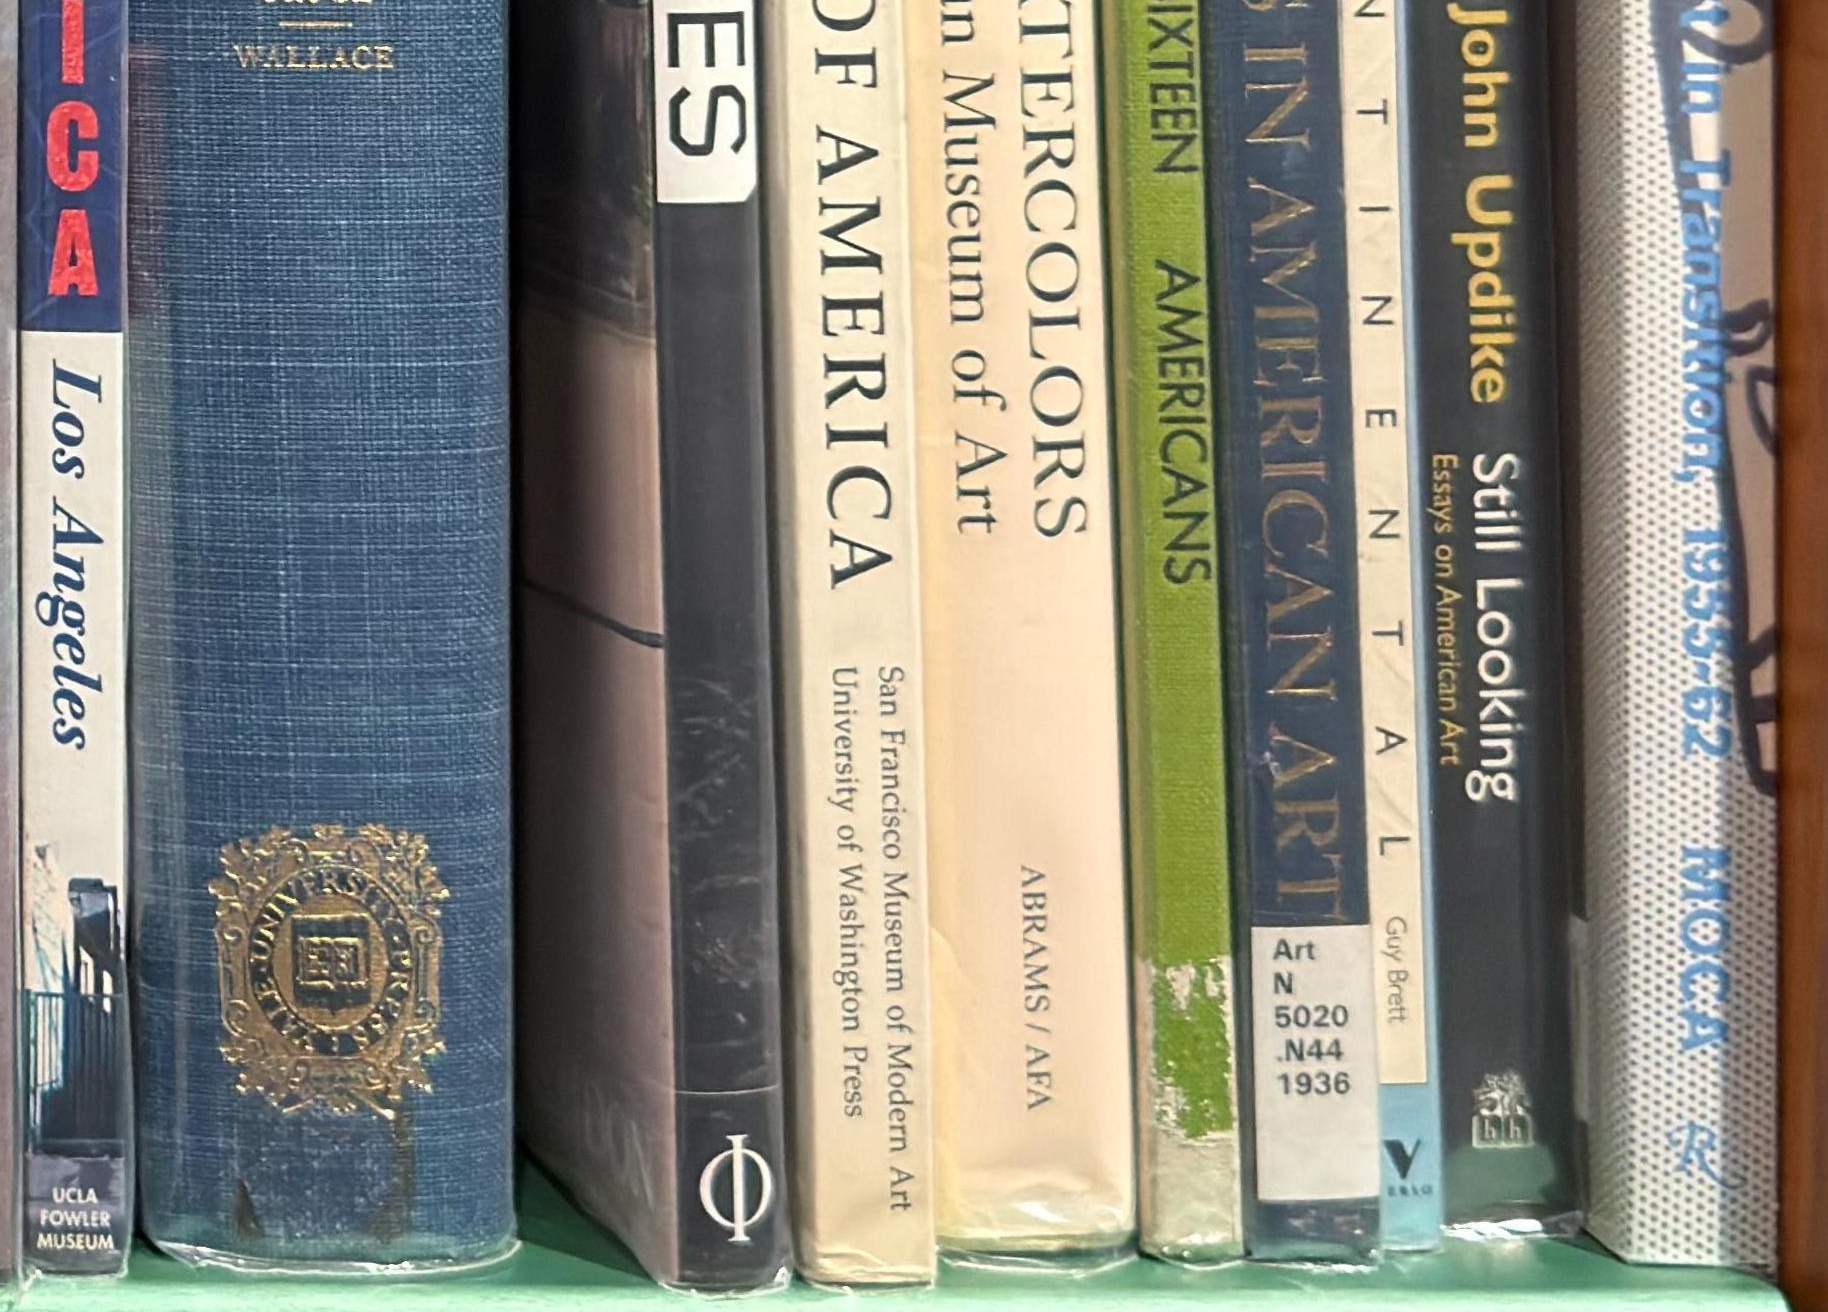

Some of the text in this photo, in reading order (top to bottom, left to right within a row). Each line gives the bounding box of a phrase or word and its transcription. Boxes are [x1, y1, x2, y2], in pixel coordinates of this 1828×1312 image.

[943, 71, 996, 324] Museum
[1447, 3, 1515, 402] John Updike
[52, 359, 102, 479] Los
[816, 125, 893, 589] AMERICA
[1156, 260, 1211, 584] AMERICANS
[955, 431, 1008, 533] Art
[35, 496, 104, 750] Angeles
[1426, 455, 1466, 764] Essays American Art
[1465, 454, 1525, 801] Still Looking
[827, 667, 868, 1117] University Washington Press
[879, 667, 914, 1210] San Francisco Museum Modern Art
[1021, 865, 1052, 1110] ABRAMS AFA
[1273, 938, 1315, 960] Art
[1381, 916, 1410, 1023] Guy Brett
[1680, 846, 1728, 1052] MOCA
[1275, 1005, 1348, 1028] 5020
[1277, 1039, 1344, 1062] .N44
[1278, 1072, 1350, 1096] 1936
[37, 1233, 114, 1249] MUSEUM
[40, 1209, 111, 1227] FOWLER
[53, 1188, 98, 1203] UCLA
